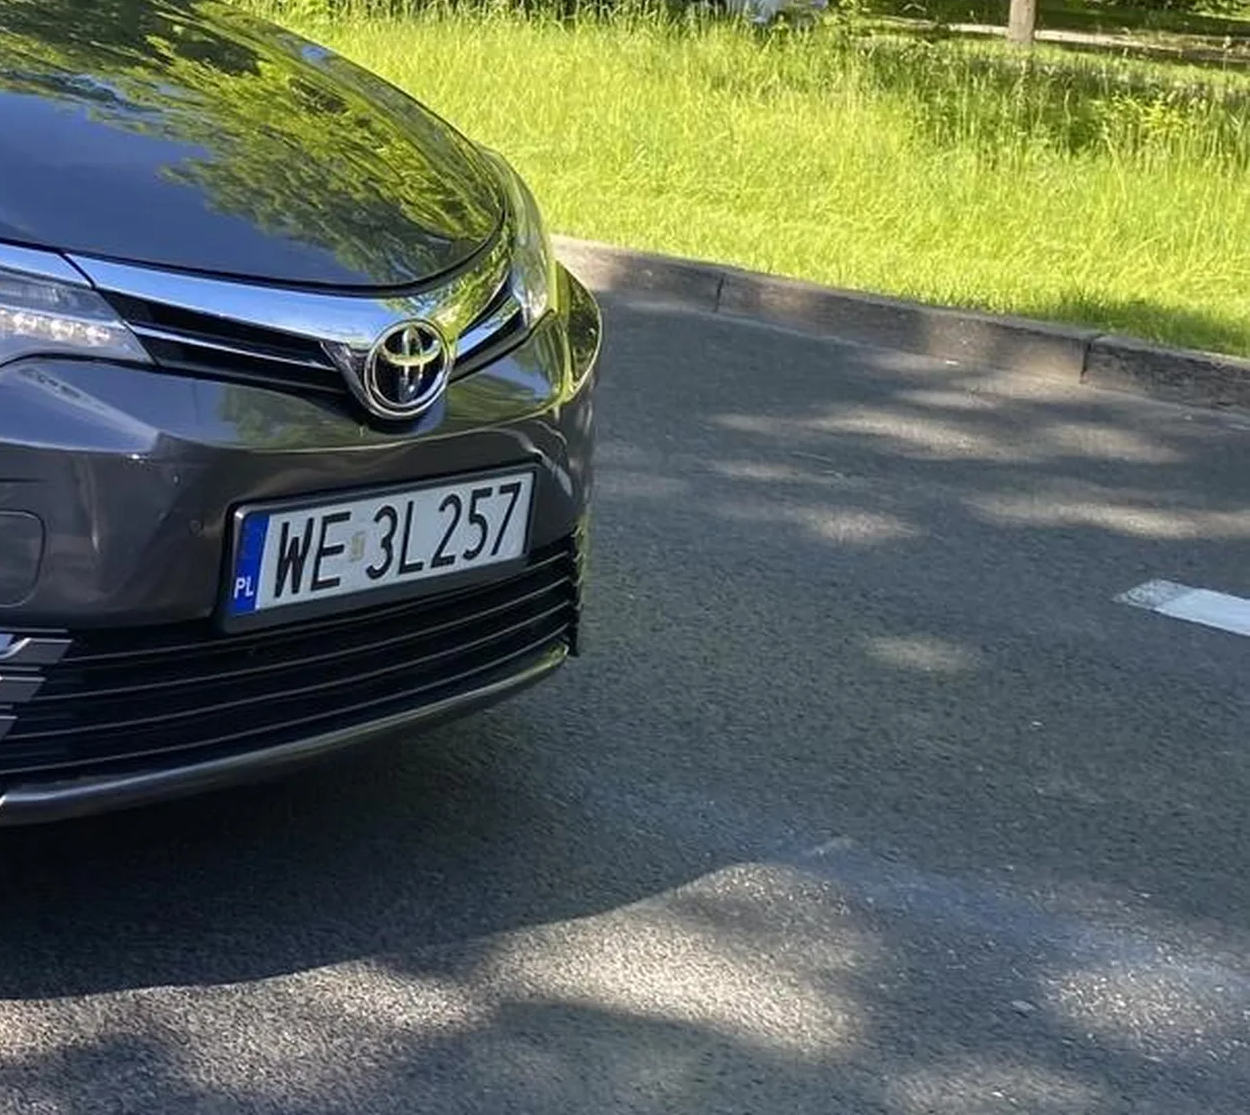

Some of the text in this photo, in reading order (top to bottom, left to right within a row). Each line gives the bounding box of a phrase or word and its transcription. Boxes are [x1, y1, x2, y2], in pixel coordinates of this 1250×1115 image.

[273, 481, 522, 598] WE 3L257
[233, 577, 254, 599] PL
